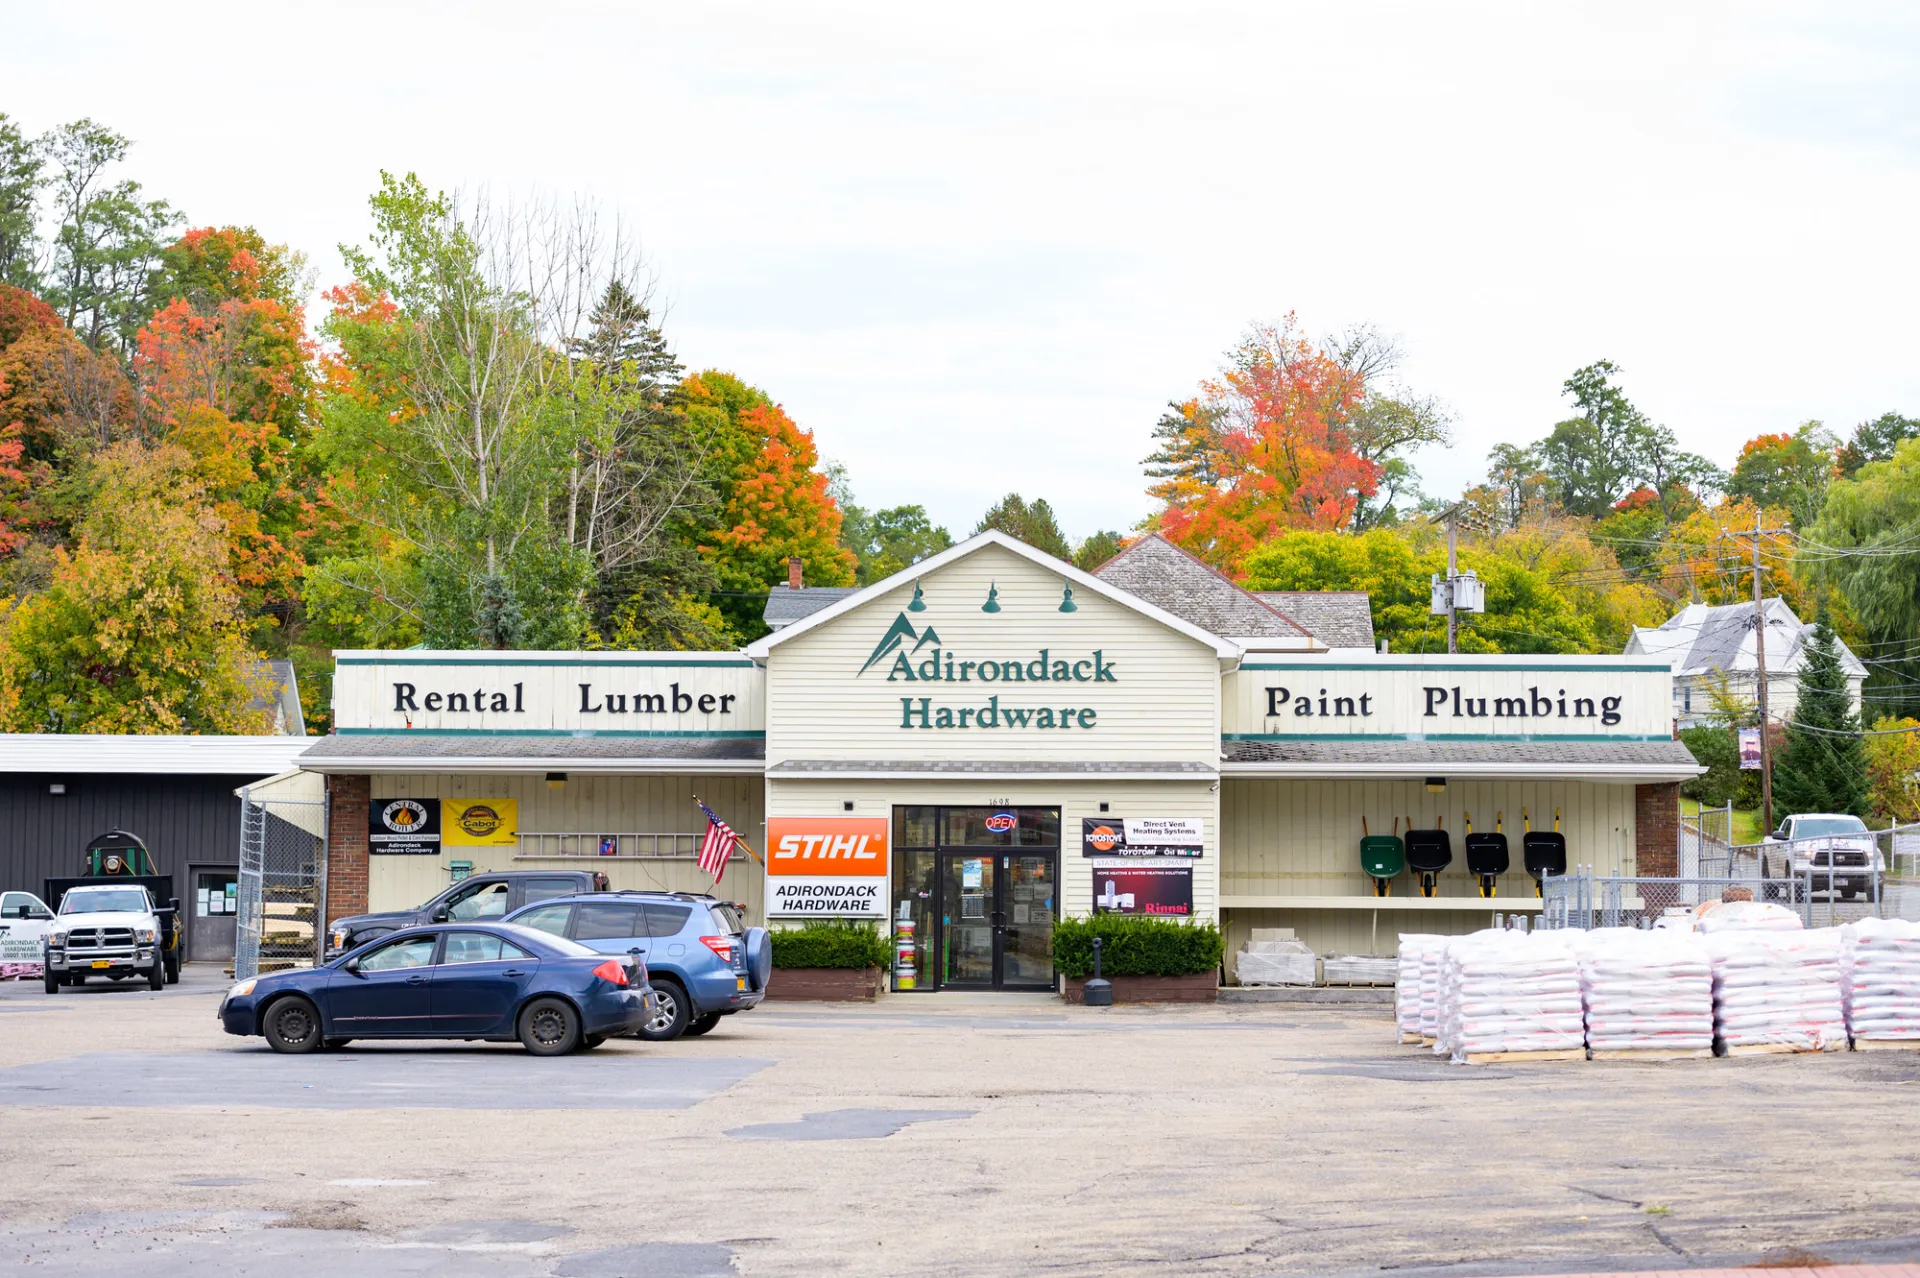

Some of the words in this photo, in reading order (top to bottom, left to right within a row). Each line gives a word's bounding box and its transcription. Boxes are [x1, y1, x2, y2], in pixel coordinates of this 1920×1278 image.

[887, 648, 1118, 682] Adirondack
[393, 682, 525, 712] Rental
[579, 682, 737, 714] Lumber
[1264, 686, 1373, 717] Paint
[900, 694, 1097, 729] Hardware
[1423, 686, 1622, 726] Plumbing
[384, 801, 424, 816] CENTRAL
[989, 798, 1010, 806] 1698
[388, 820, 422, 832] BOILER
[985, 816, 1018, 829] OPEN
[774, 834, 878, 859] STIHL
[1164, 847, 1175, 856] Oil
[776, 885, 878, 897] ADIRONDACK
[782, 900, 871, 911] HARDWARE
[1144, 902, 1188, 914] Rinnai
